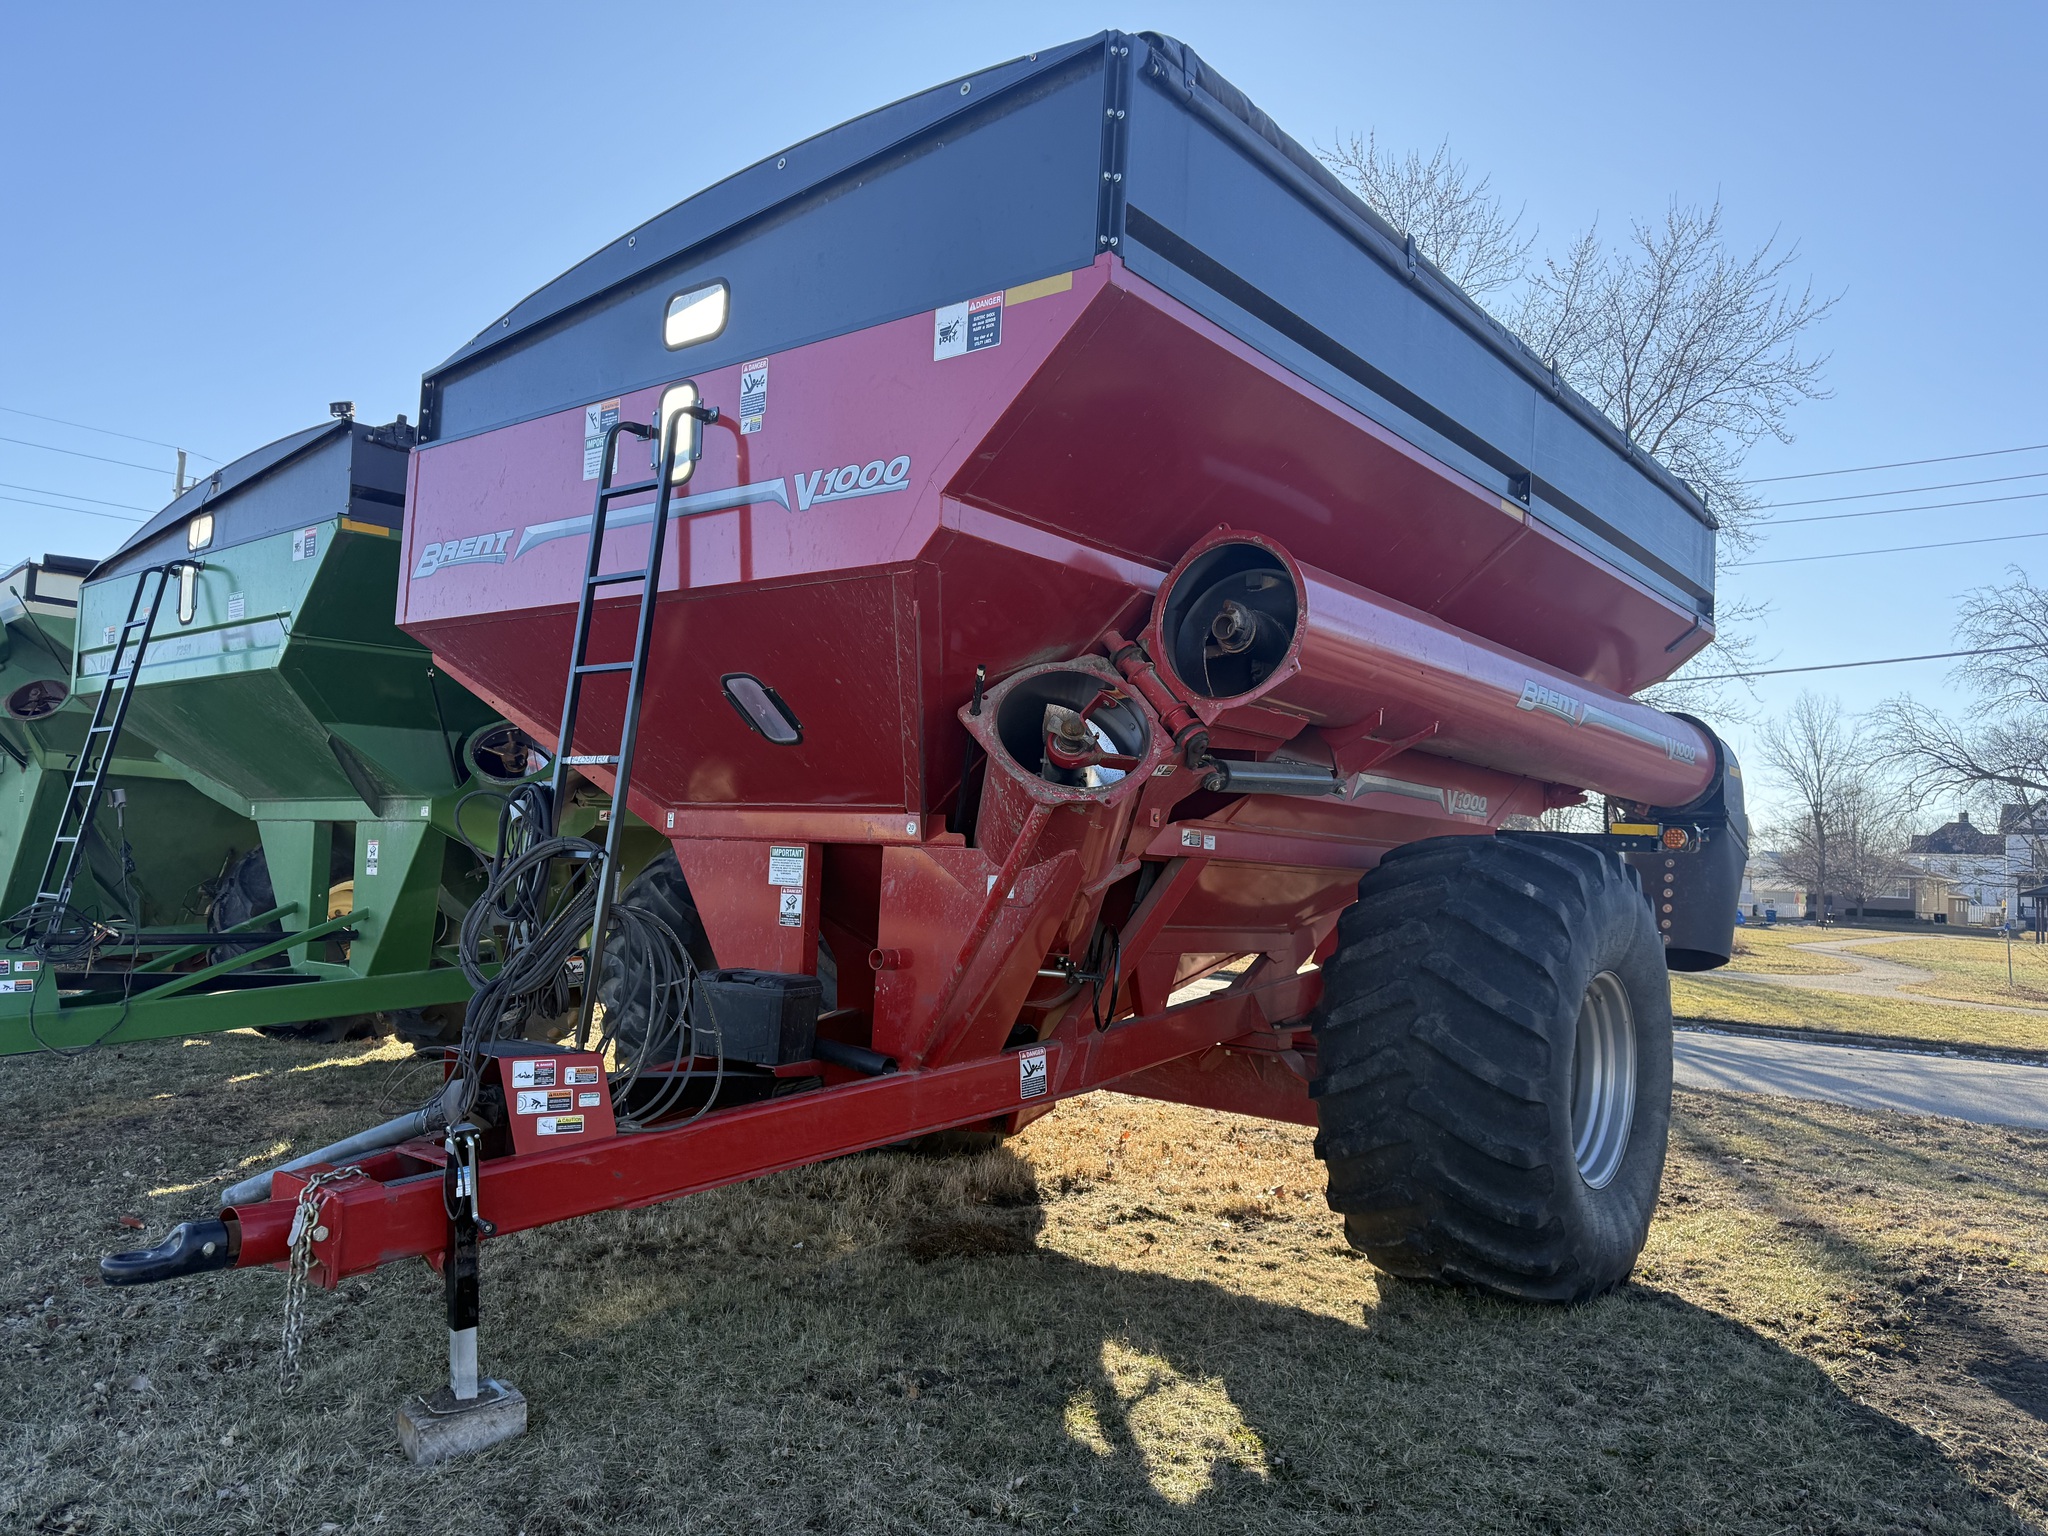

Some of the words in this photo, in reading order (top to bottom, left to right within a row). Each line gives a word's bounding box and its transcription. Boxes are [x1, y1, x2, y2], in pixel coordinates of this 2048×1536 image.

[976, 296, 1001, 309] DANGER
[748, 361, 767, 371] DANGER
[586, 436, 605, 449] IMPOR
[794, 455, 911, 512] V1000
[411, 528, 516, 580] BRENT
[1516, 679, 1579, 720] BRENT
[1668, 737, 1696, 764] V1000
[65, 754, 103, 772] 70
[1447, 789, 1488, 815] V1000
[771, 848, 803, 858] IMPORTANT
[1026, 1049, 1044, 1058] DANGER
